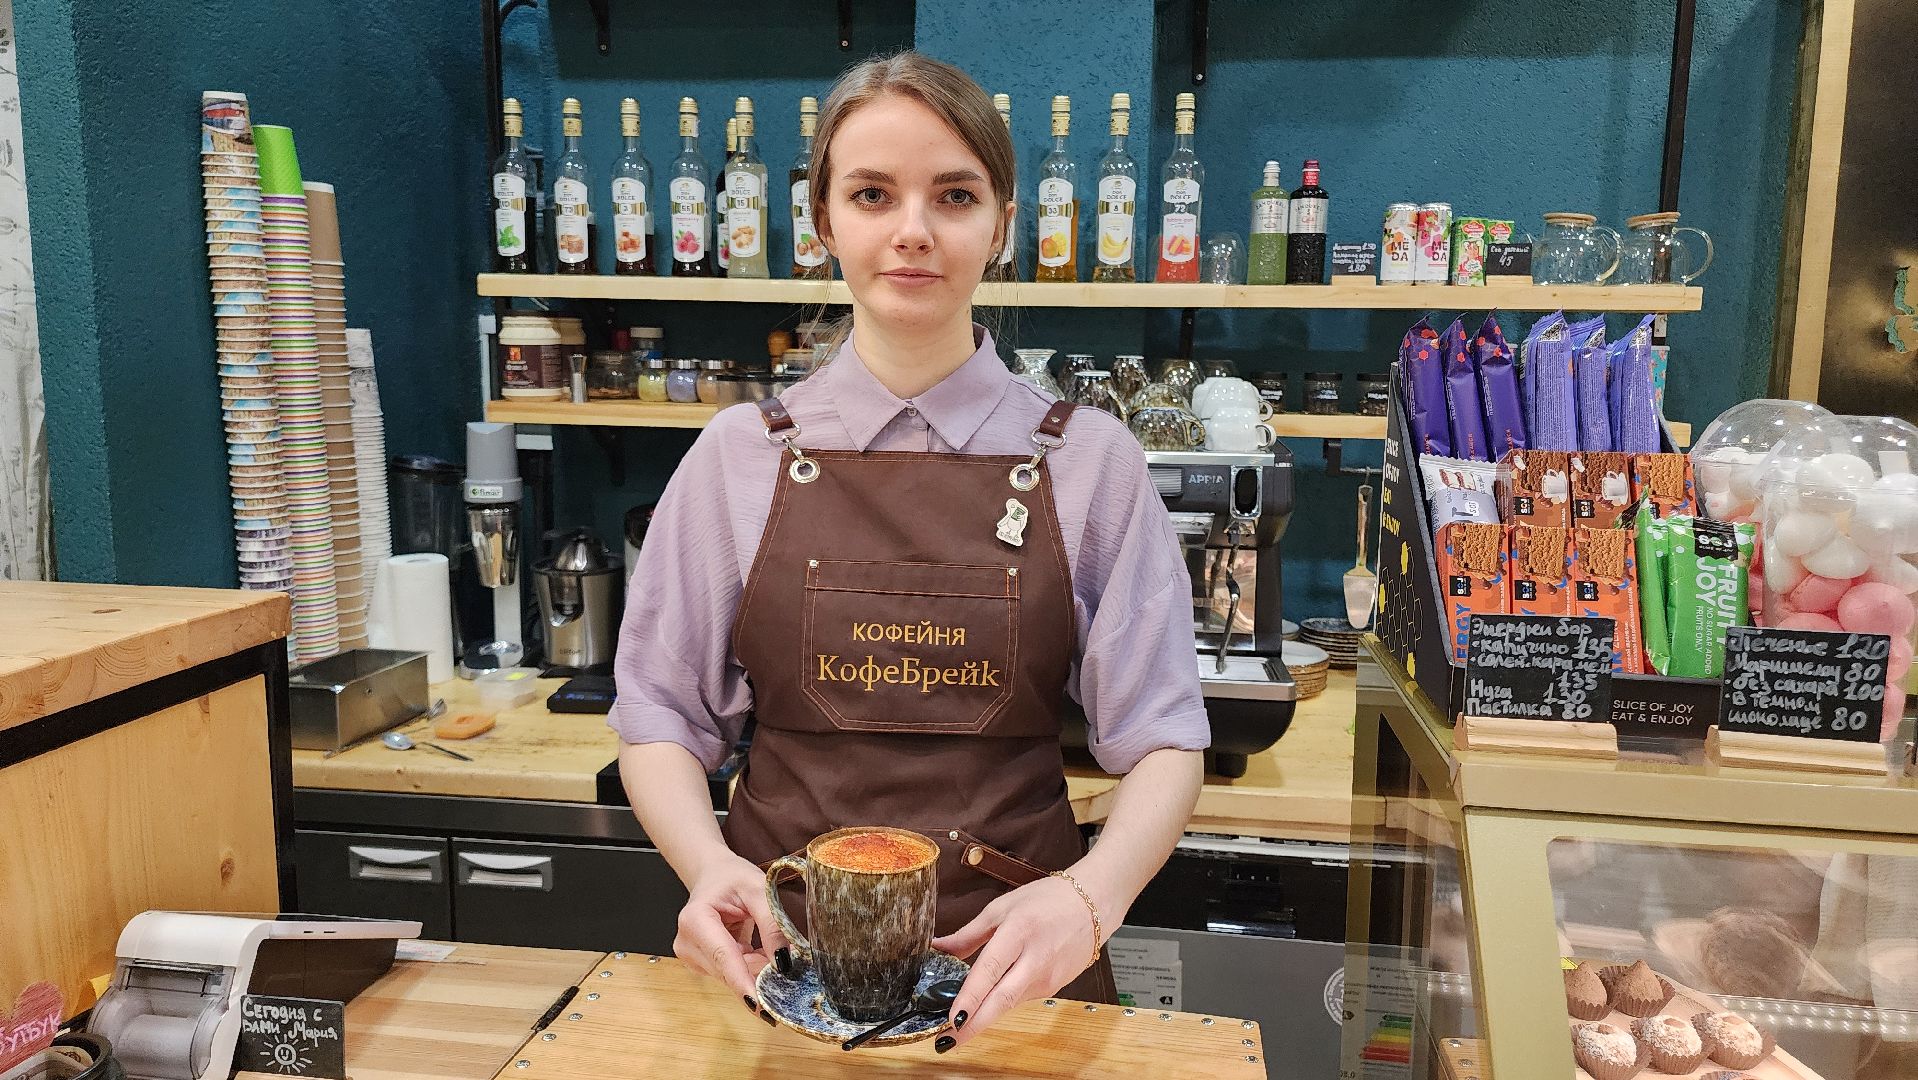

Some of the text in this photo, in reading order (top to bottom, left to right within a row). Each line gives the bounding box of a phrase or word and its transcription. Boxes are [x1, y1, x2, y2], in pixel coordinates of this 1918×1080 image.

[1499, 255, 1514, 267] 45
[1188, 474, 1225, 484] APPIA
[1695, 557, 1717, 607] JOY
[1707, 607, 1714, 619] NO
[852, 620, 967, 647] КОФЕЙНЯ
[1695, 605, 1703, 653] FRUITS ONLY
[1571, 637, 1614, 662] 135
[1834, 633, 1890, 660] 120
[1705, 648, 1713, 675] ADDED
[1844, 662, 1881, 682] 80
[1470, 678, 1587, 705] Нуга 130
[1556, 671, 1598, 691] 135
[1843, 682, 1885, 701] 100
[1466, 698, 1593, 720] Пастилка 80
[1611, 711, 1693, 726] EAT & ENJOY
[1612, 699, 1695, 714] SLICE OF JOY
[1831, 707, 1867, 731] 80
[242, 997, 307, 1024] Сегодня
[287, 1021, 339, 1048] Мария
